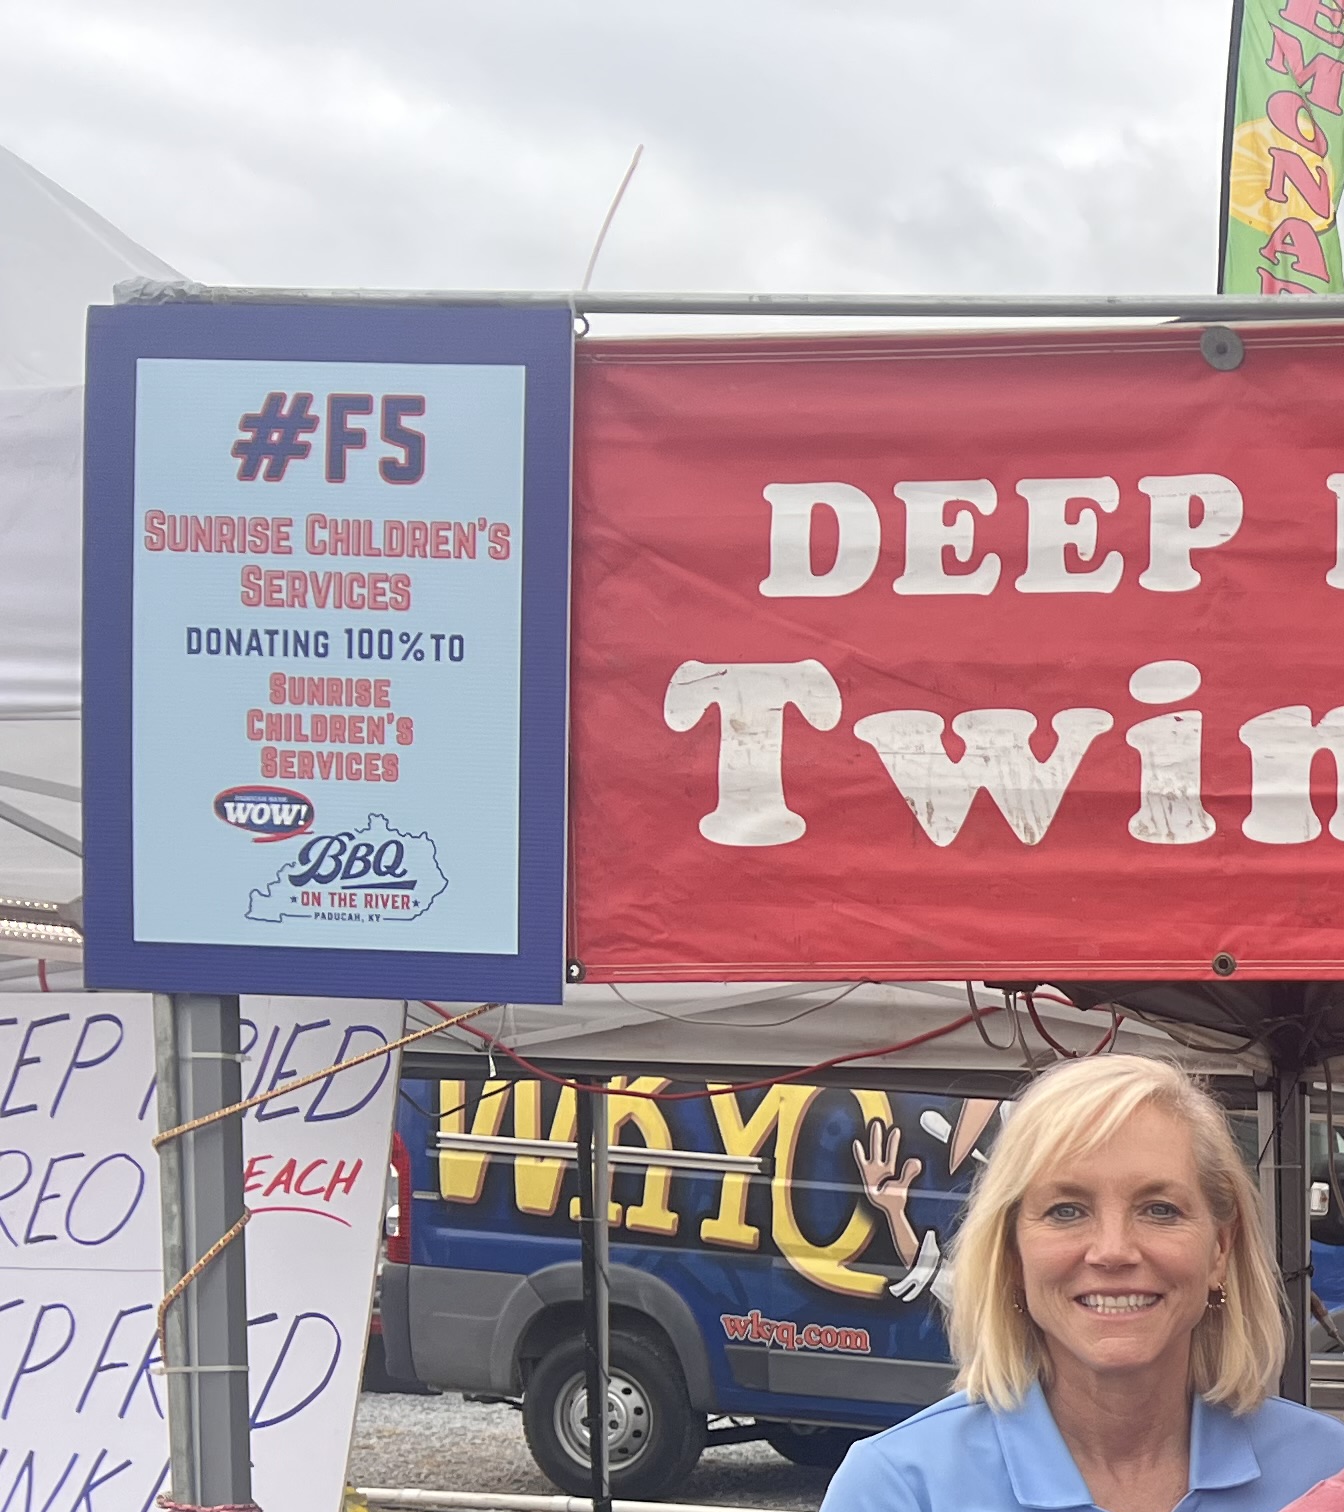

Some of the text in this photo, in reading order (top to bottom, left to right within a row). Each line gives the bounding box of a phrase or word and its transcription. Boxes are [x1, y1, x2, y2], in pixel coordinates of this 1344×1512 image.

[231, 392, 426, 485] #F5
[144, 509, 293, 555] SUNRISE
[759, 474, 1244, 597] DEEP
[241, 564, 411, 611] SERVICES
[186, 626, 330, 658] DONATING
[269, 672, 391, 708] SUNRISE
[260, 746, 399, 782] SERVICES
[224, 801, 309, 825] WOW!
[288, 832, 407, 887] BBQ
[301, 891, 410, 910] ON THE RIVER
[314, 912, 381, 923] PADUCAH, KY
[0, 1012, 124, 1118] EP
[243, 1154, 363, 1202] EACH
[438, 1076, 888, 1299] WKYQ
